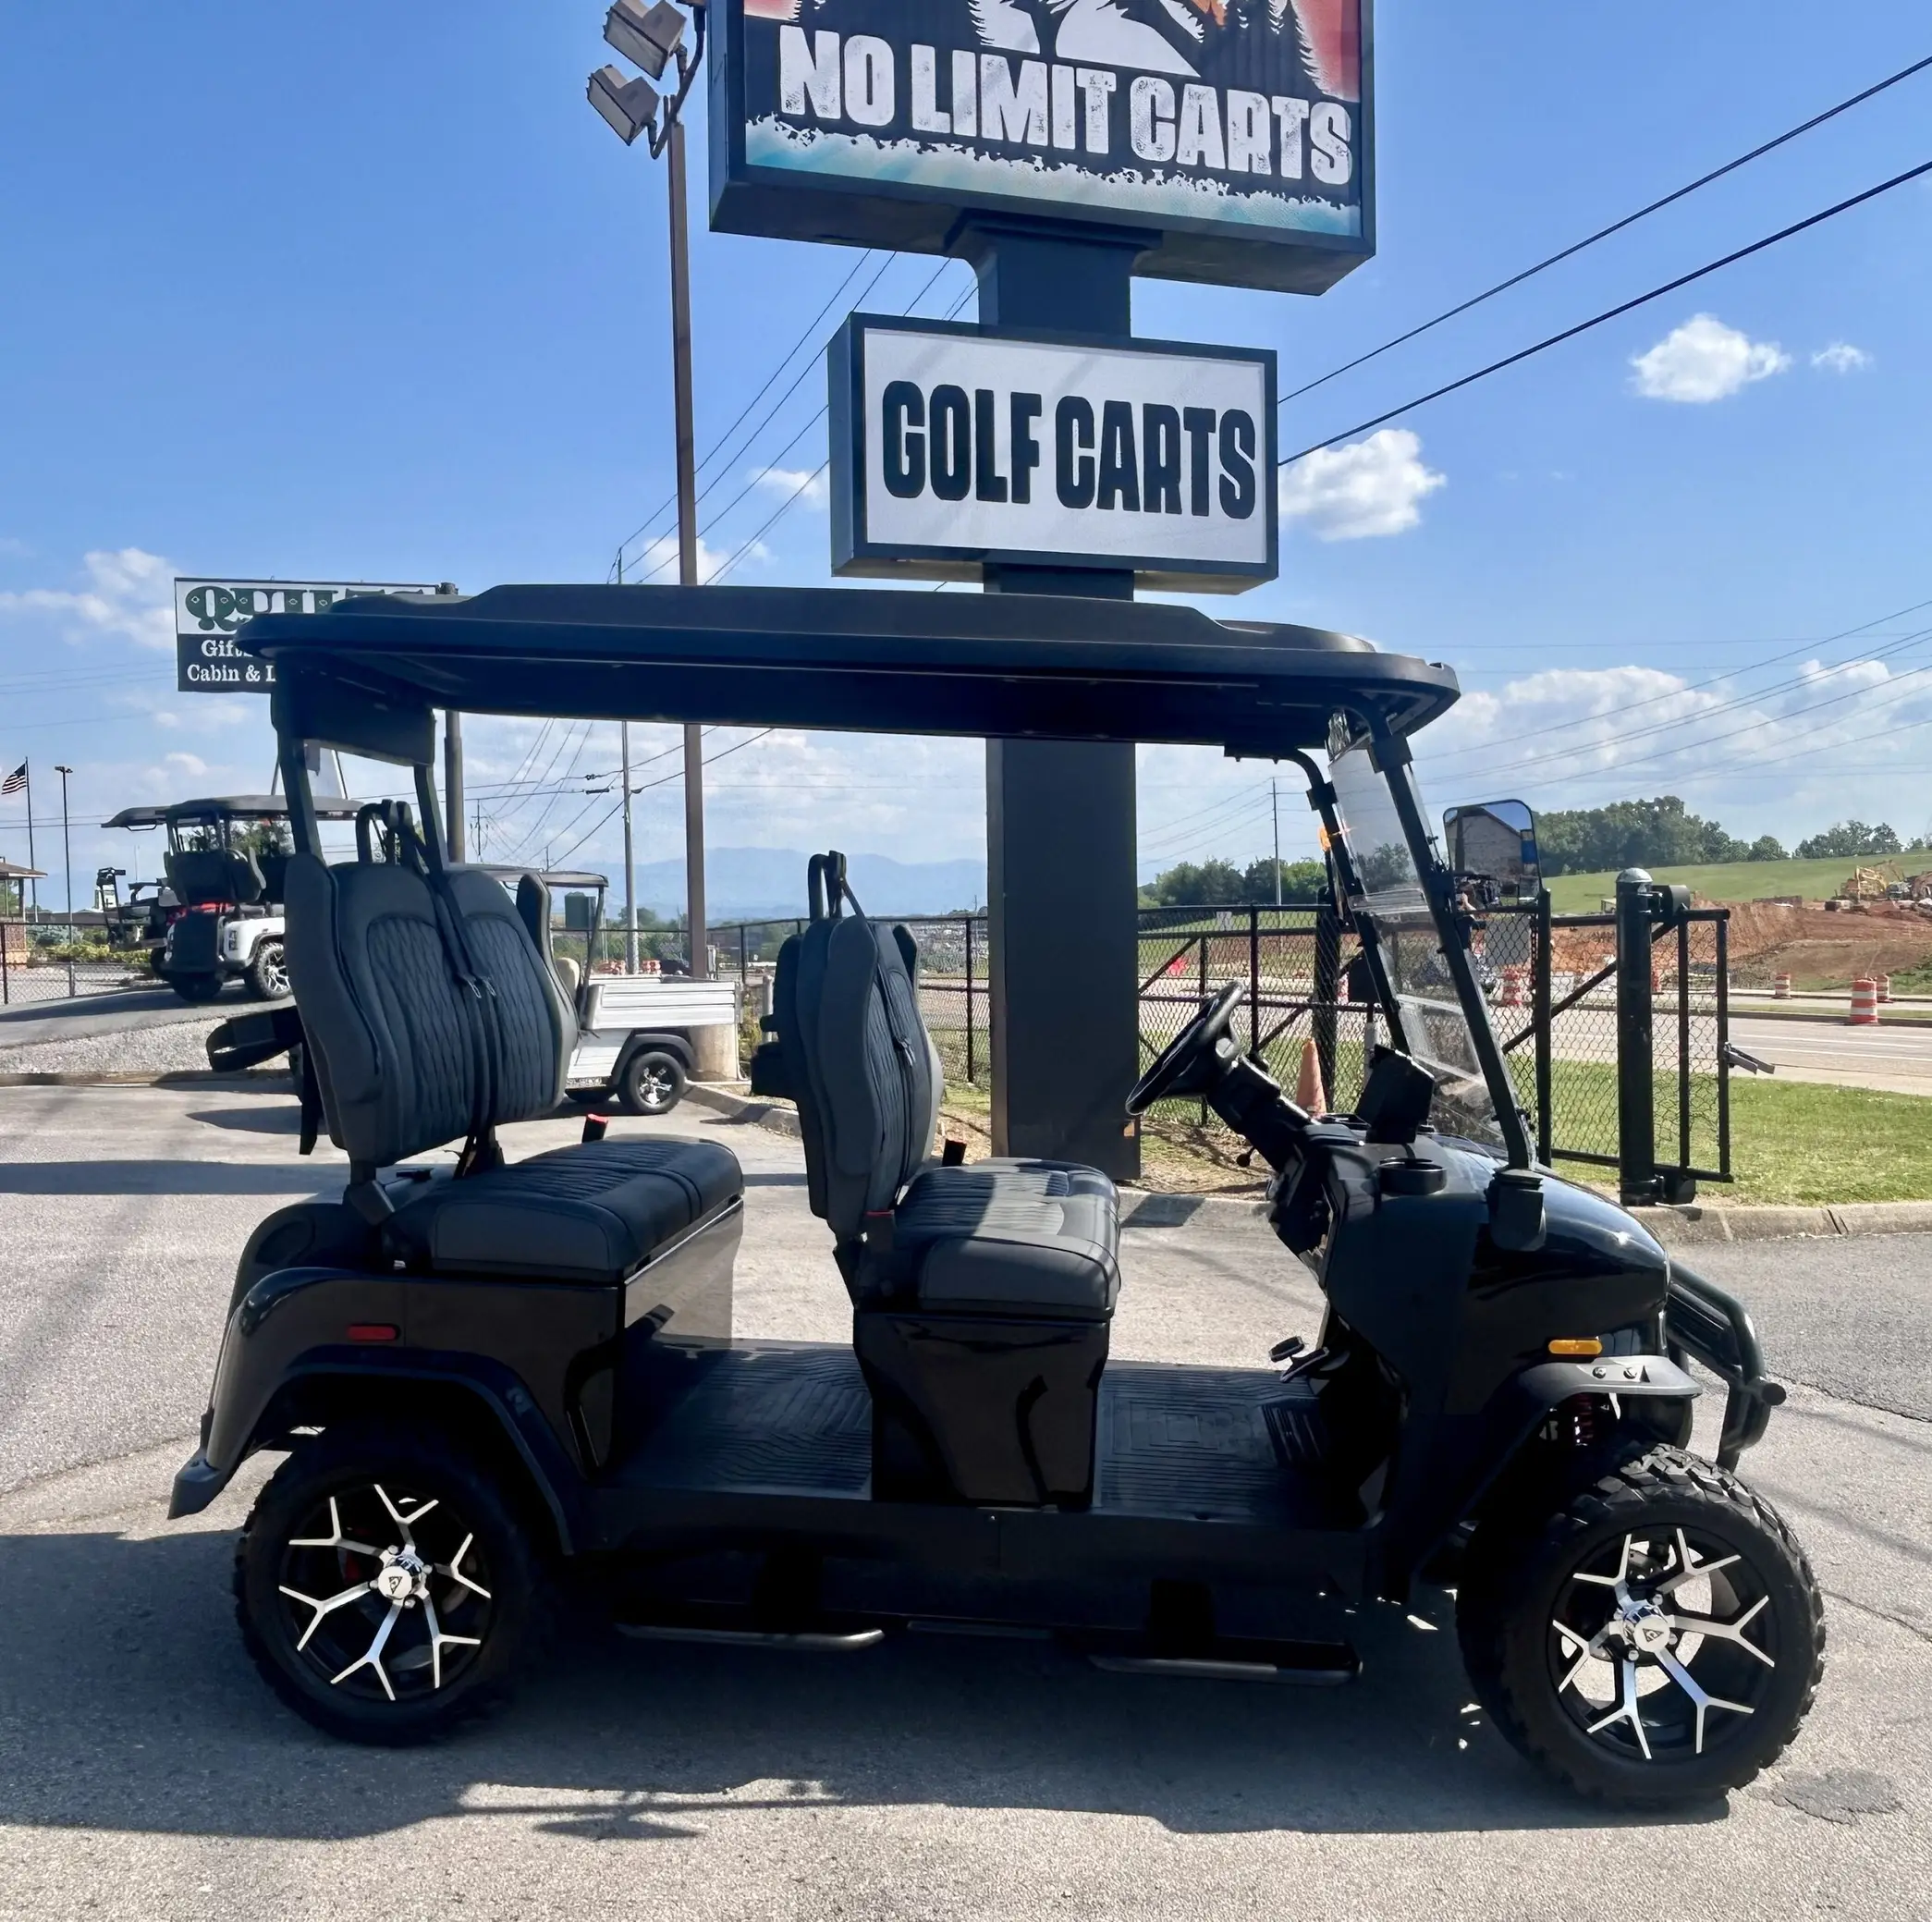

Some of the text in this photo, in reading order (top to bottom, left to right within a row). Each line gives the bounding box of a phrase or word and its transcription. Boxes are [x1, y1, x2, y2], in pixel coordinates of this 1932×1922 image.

[779, 24, 1353, 185] NO LIMIT CARTS
[882, 380, 1256, 520] GOLF CARTS
[187, 663, 240, 682] Cabin
[245, 664, 261, 682] &
